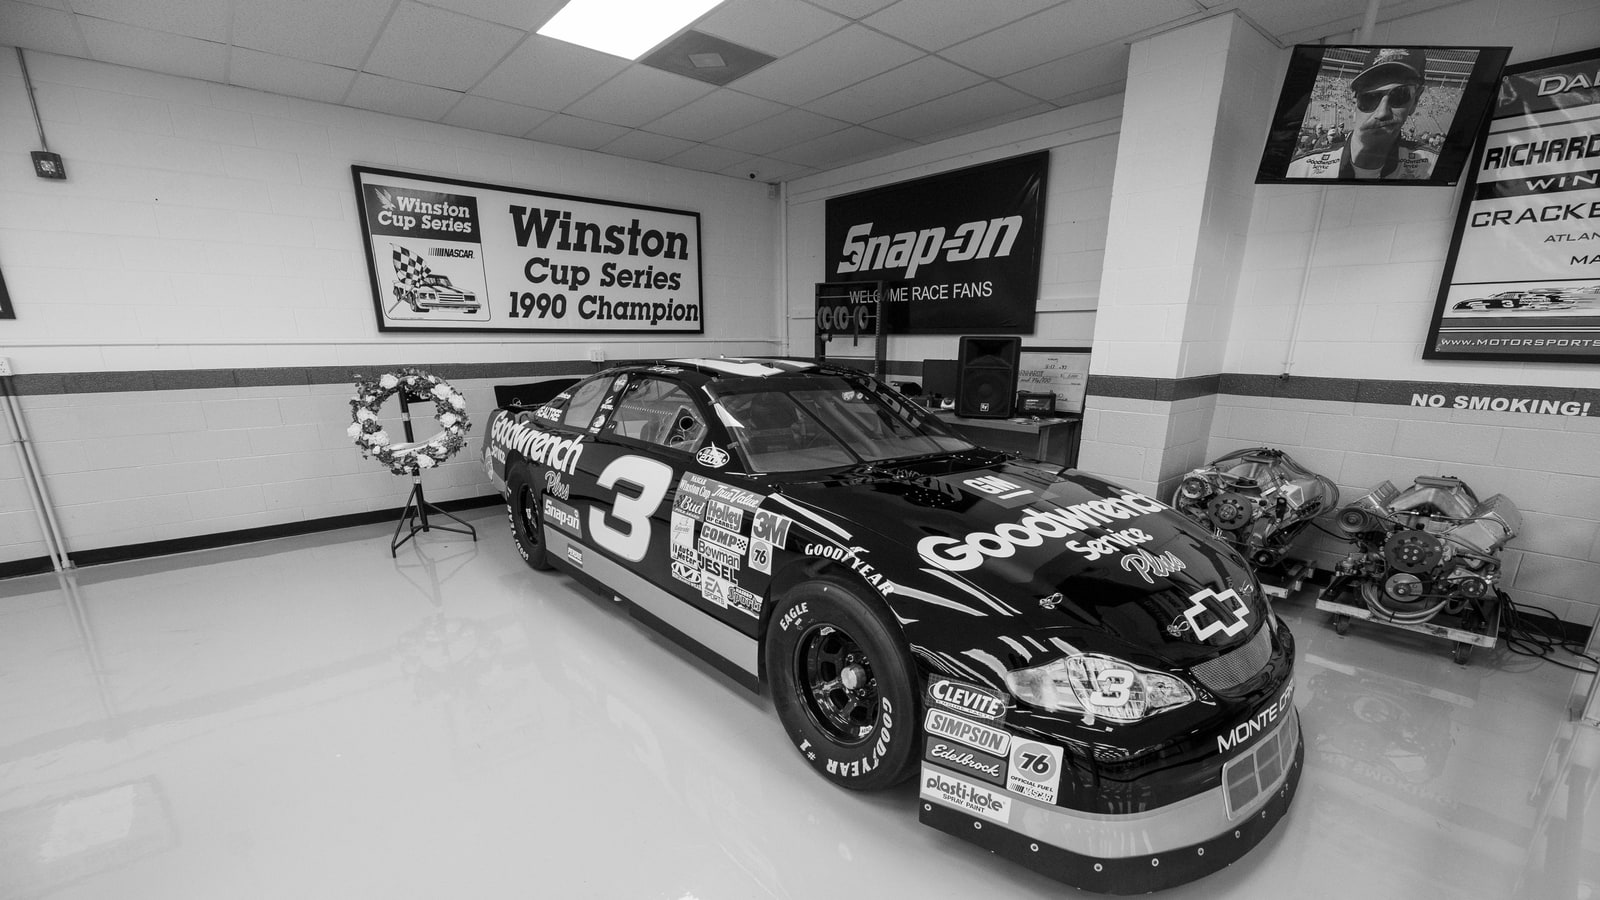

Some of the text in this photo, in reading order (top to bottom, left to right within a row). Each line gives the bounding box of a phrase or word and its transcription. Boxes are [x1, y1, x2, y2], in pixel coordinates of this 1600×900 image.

[1538, 72, 1600, 97] DA
[377, 210, 473, 234] Cup Series
[396, 195, 470, 219] Winston
[508, 204, 689, 261] Winston
[836, 215, 1023, 280] Snap-on
[443, 248, 475, 260] NASCAR
[524, 256, 682, 292] Cup Series
[850, 280, 993, 304] WELCME RACE FANS
[1501, 300, 1515, 308] 3
[508, 291, 700, 326] 1990 Champion
[1411, 393, 1592, 418] NO SMOKING!
[491, 410, 585, 476] Goodwrench
[545, 470, 570, 501] Plus
[963, 475, 1022, 495] GM
[544, 499, 580, 530] Snap-on
[588, 454, 674, 563] 3
[681, 495, 706, 516] Bud
[708, 500, 742, 531] Holley
[701, 525, 738, 548] COMP
[753, 511, 790, 547] 3M
[917, 489, 1169, 572] Goodwrench
[1065, 527, 1153, 562] Service
[697, 555, 739, 586] JESEL
[698, 540, 740, 570] Bowman
[754, 549, 768, 565] 76
[805, 543, 895, 597] GOODYEAR
[1120, 549, 1187, 584] Plus
[704, 576, 724, 598] EA
[779, 602, 809, 632] EAGLE
[932, 680, 1002, 716] CLEVITE
[1090, 669, 1134, 708] 3
[826, 696, 893, 777] GOODYEAR
[931, 714, 1004, 751] SIMPSON
[1217, 702, 1278, 754] MONTE
[931, 744, 1000, 777] Edelbrock
[1020, 752, 1050, 774] 76
[926, 775, 1004, 812] plasti-kote
[1011, 775, 1054, 793] OFFICIAL FUEL
[942, 793, 986, 813] SPRAY PAINT
